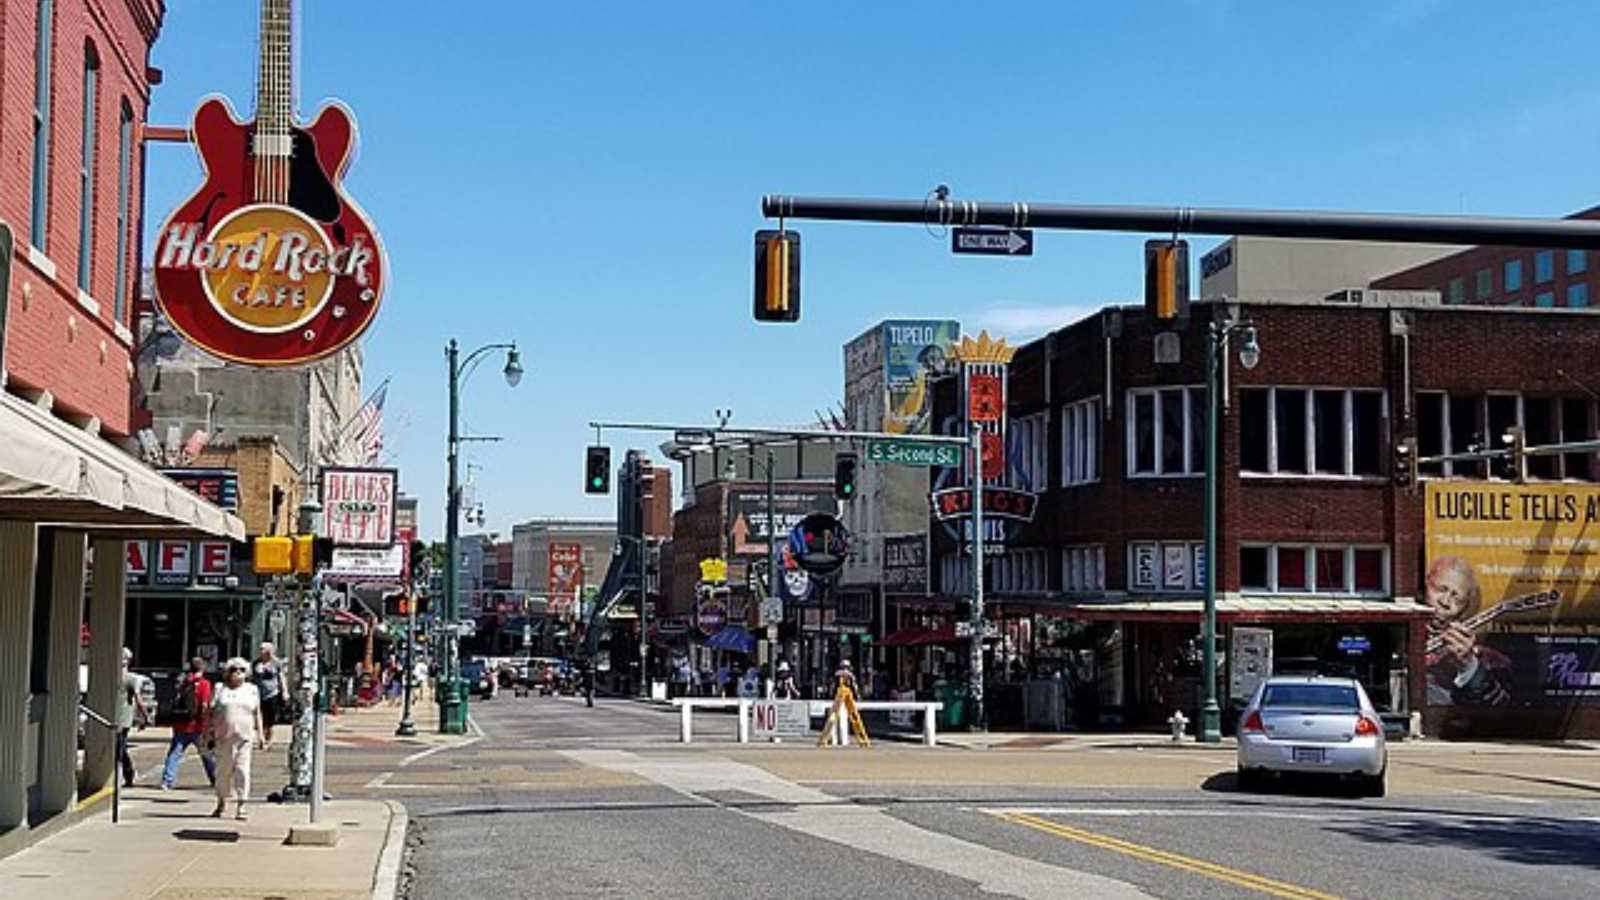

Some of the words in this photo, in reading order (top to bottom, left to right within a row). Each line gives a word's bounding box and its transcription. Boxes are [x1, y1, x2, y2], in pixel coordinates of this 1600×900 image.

[159, 221, 269, 272] Hard
[274, 228, 375, 286] Rock
[962, 235, 981, 248] ONE
[986, 235, 1009, 248] WAY
[231, 284, 306, 308] CAFE
[891, 326, 934, 346] TUPELO
[887, 444, 935, 463] Second
[329, 473, 390, 502] BLUES
[1435, 491, 1512, 521] LUCILLE
[1519, 493, 1577, 522] TELLS
[756, 703, 776, 731] NO
